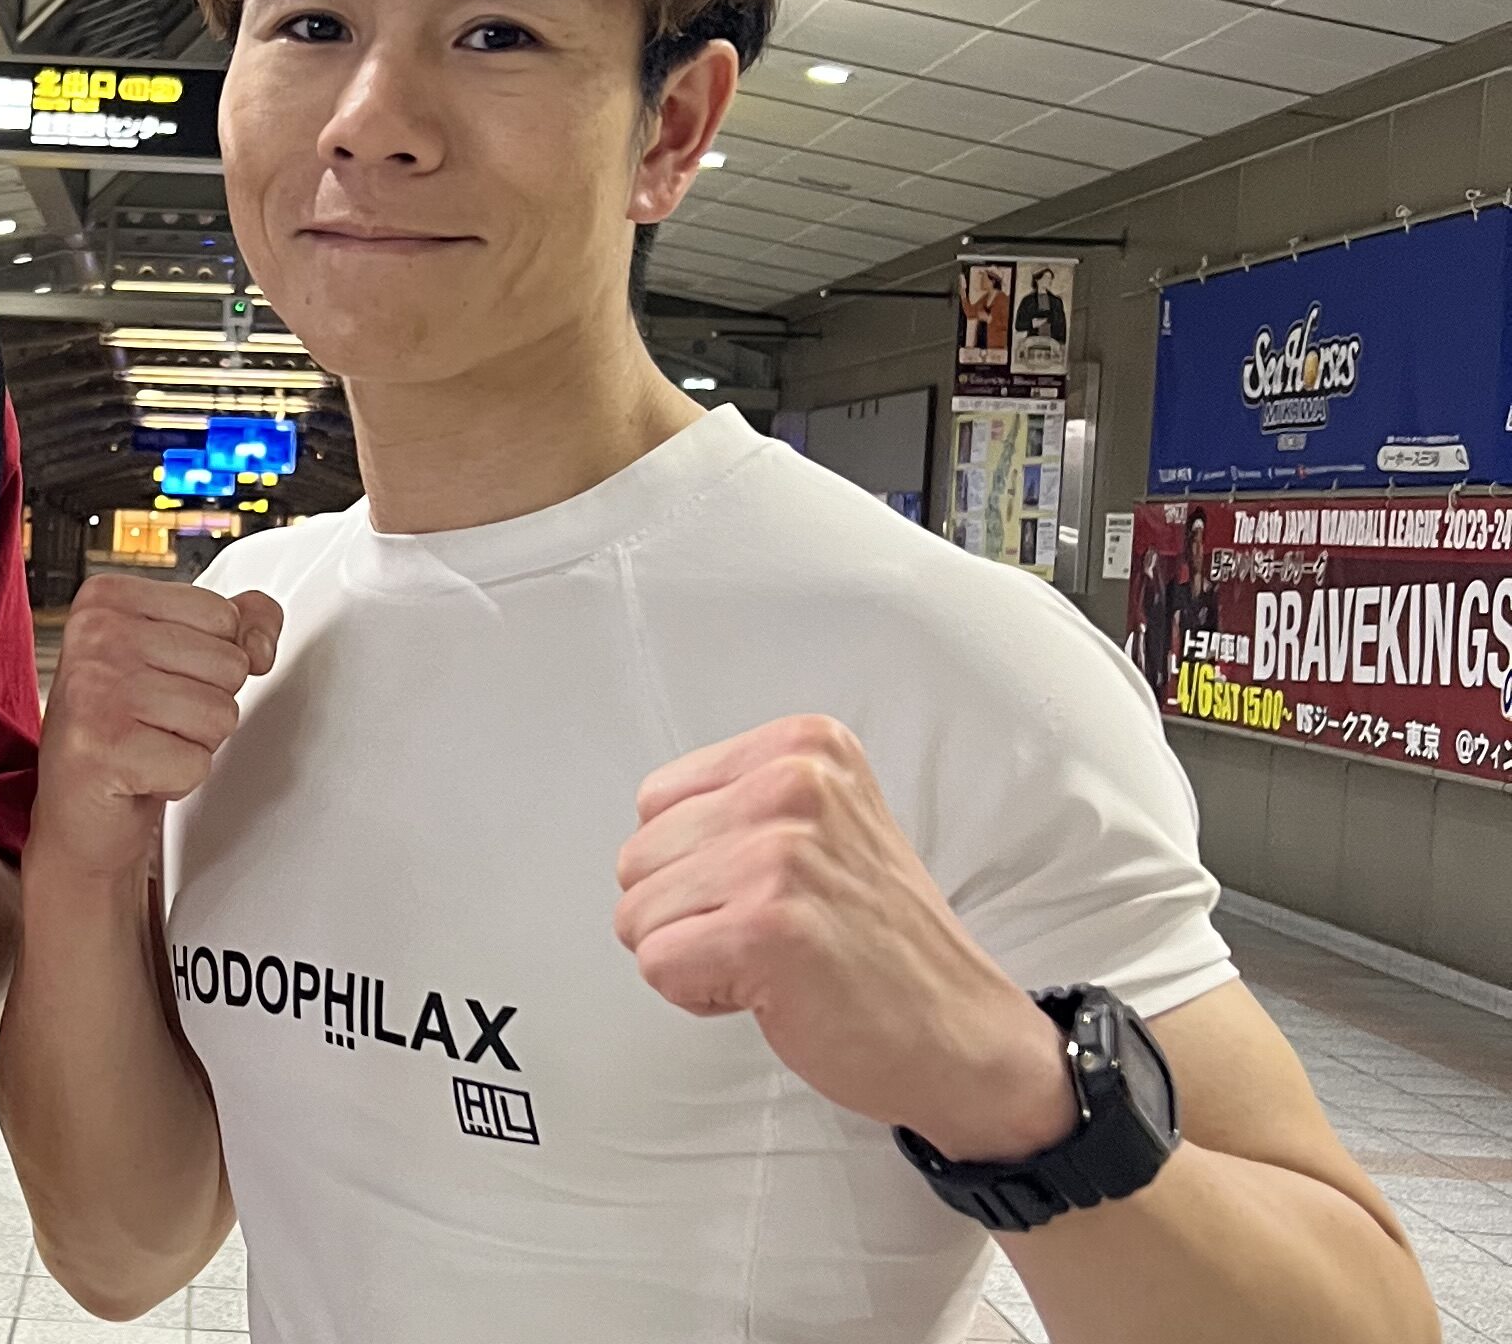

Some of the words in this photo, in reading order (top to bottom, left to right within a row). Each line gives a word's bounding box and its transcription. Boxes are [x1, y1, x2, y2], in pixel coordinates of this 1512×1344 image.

[1233, 510, 1255, 544] The
[1282, 509, 1319, 545] JAPAN
[1320, 509, 1386, 547] HANDBALL
[1387, 509, 1443, 548] LEAGUE
[1443, 508, 1512, 550] 2023-24
[1252, 578, 1512, 690] BRAVEKINGS
[172, 942, 522, 1073] HODOPHILAX
